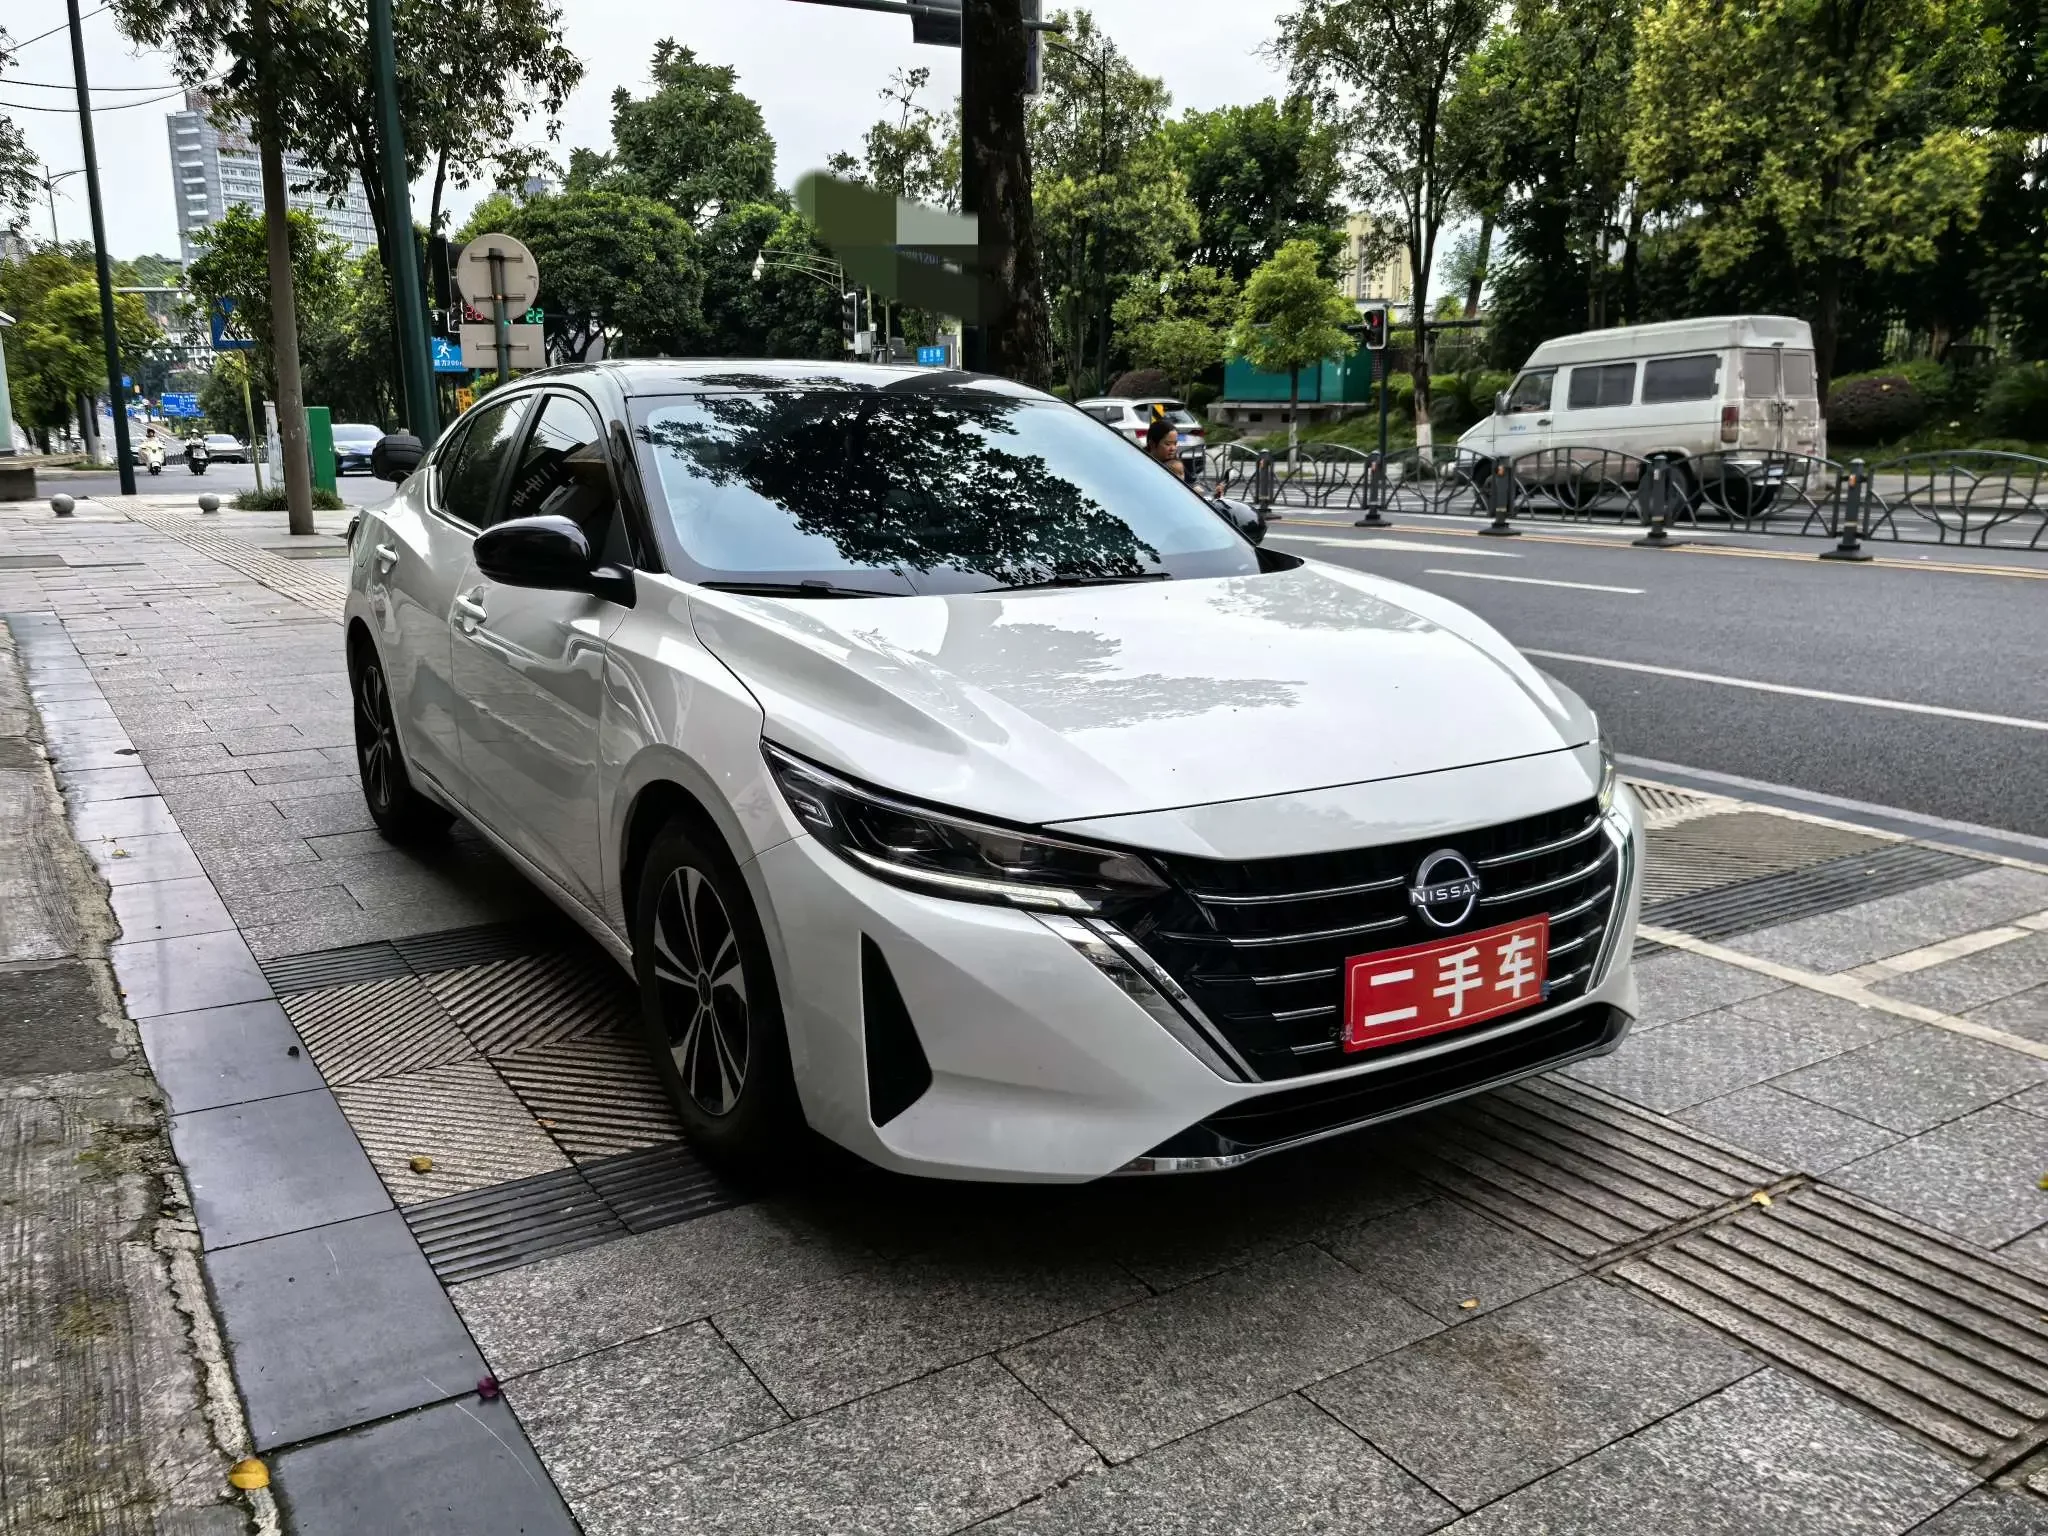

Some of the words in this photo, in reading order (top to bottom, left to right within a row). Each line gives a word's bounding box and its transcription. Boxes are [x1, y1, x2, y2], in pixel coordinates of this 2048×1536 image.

[1411, 880, 1481, 904] NISSAN
[1364, 934, 1536, 1027] 二手车
